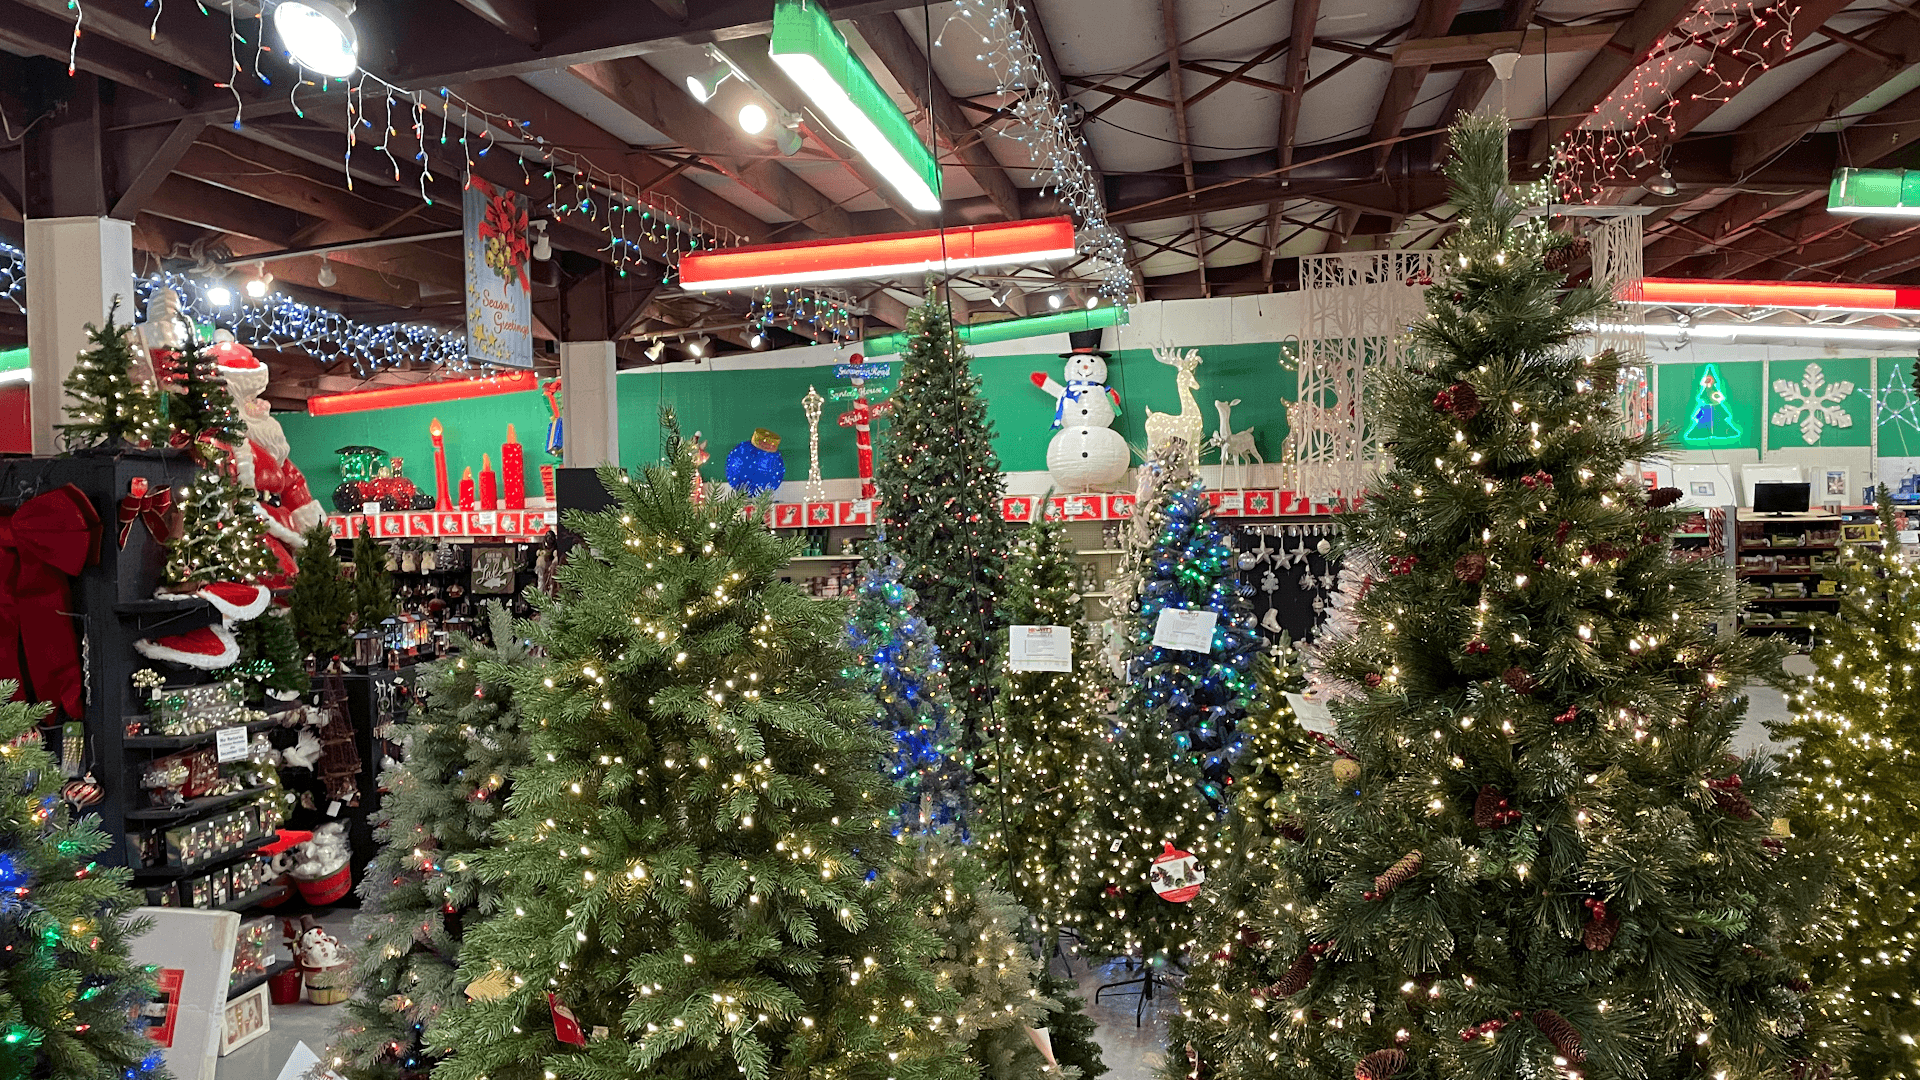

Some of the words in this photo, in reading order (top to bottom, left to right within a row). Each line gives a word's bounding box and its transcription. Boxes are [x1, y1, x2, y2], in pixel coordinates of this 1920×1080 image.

[482, 289, 515, 313] Season's
[493, 311, 530, 340] Greetings
[870, 366, 891, 377] Road
[830, 388, 858, 400] Santa's
[858, 387, 883, 398] House
[842, 412, 864, 425] North
[476, 562, 505, 585] Lake
